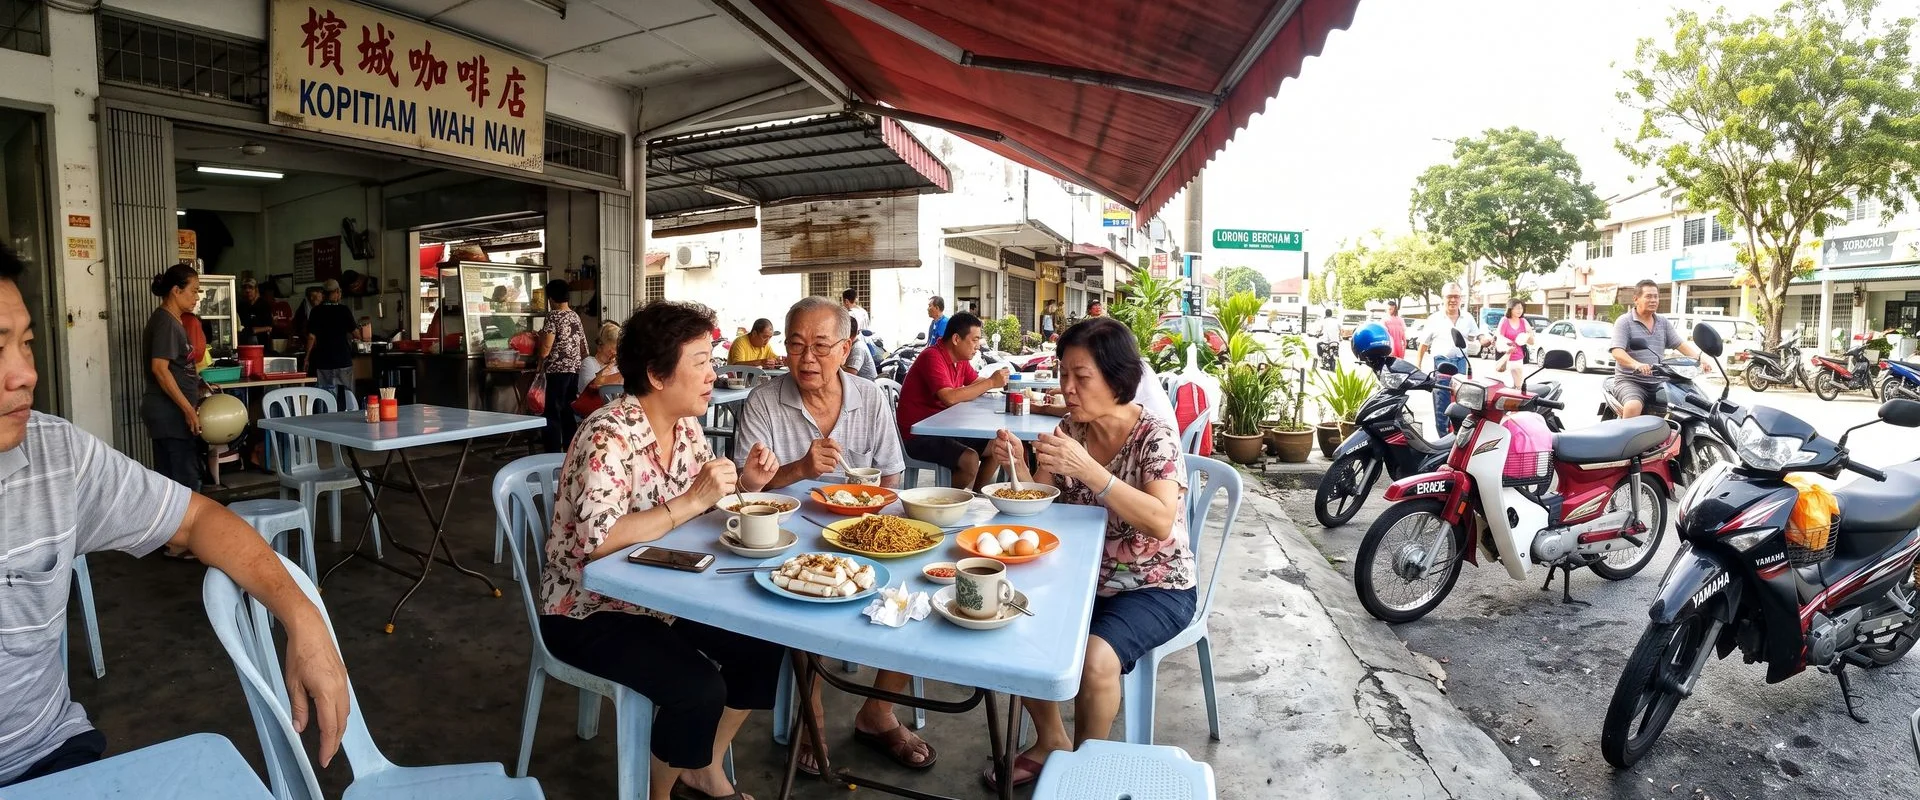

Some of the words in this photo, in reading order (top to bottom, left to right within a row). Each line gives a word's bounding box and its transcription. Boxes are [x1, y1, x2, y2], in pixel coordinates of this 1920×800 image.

[301, 6, 526, 118] 檳城咖啡店
[300, 78, 417, 135] KOPITIAM
[428, 105, 475, 146] WAH
[484, 120, 526, 157] NAM
[1217, 231, 1249, 242] LORONG
[1252, 232, 1291, 244] BERCHAM
[1293, 233, 1299, 244] 3
[1755, 551, 1785, 567] YAMAHA
[1692, 571, 1730, 609] YAMAHA
